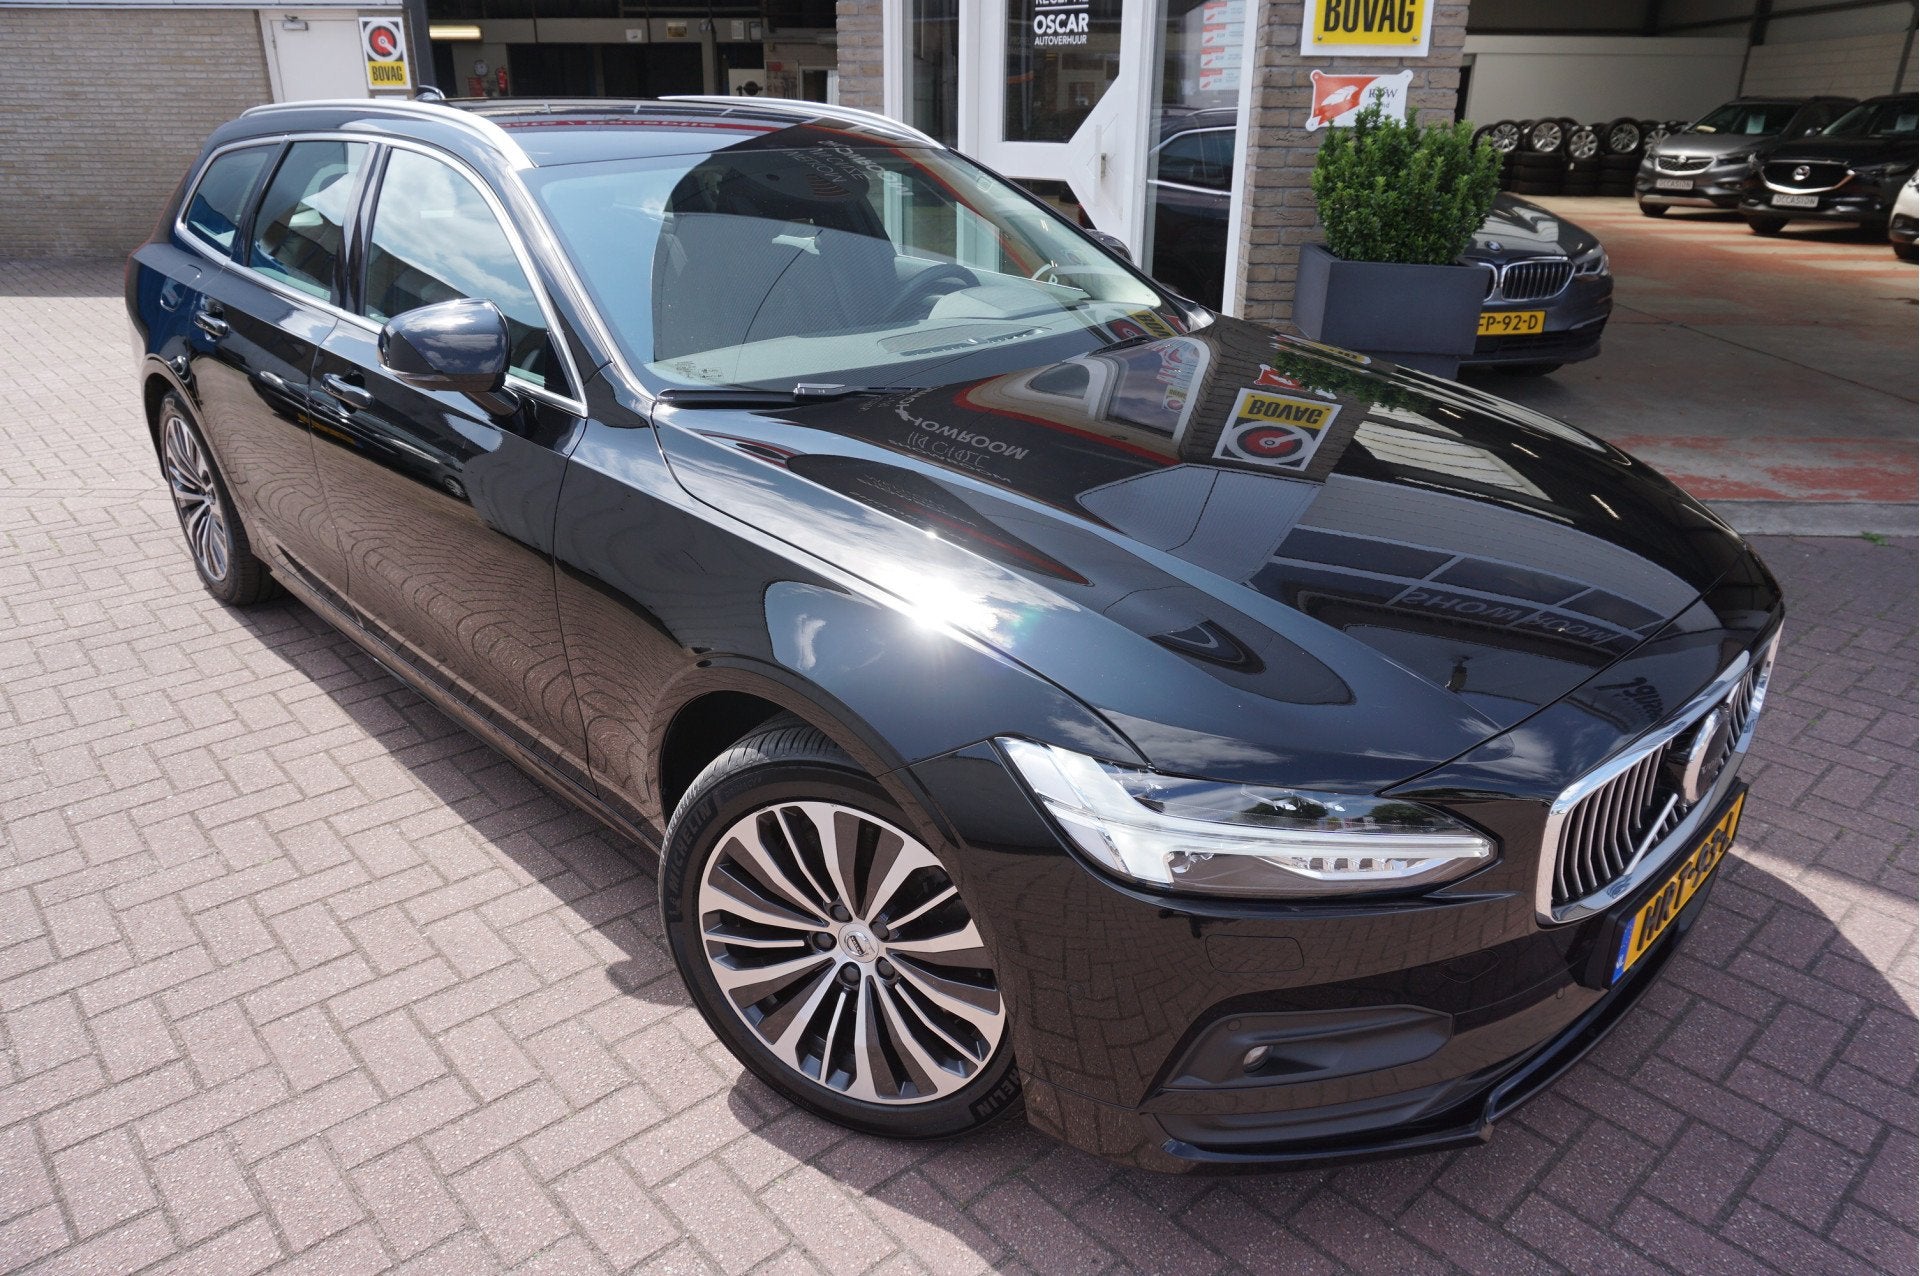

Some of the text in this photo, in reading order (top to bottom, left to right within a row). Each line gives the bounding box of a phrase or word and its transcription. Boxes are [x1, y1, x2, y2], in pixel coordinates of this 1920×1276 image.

[1034, 13, 1089, 34] OSCAR
[1323, 0, 1416, 33] BOVAG
[1034, 34, 1087, 46] AUTOVERHUUR
[371, 65, 403, 81] BOVAG
[1776, 196, 1816, 206] OCCASION
[669, 799, 713, 894] MICHELIN
